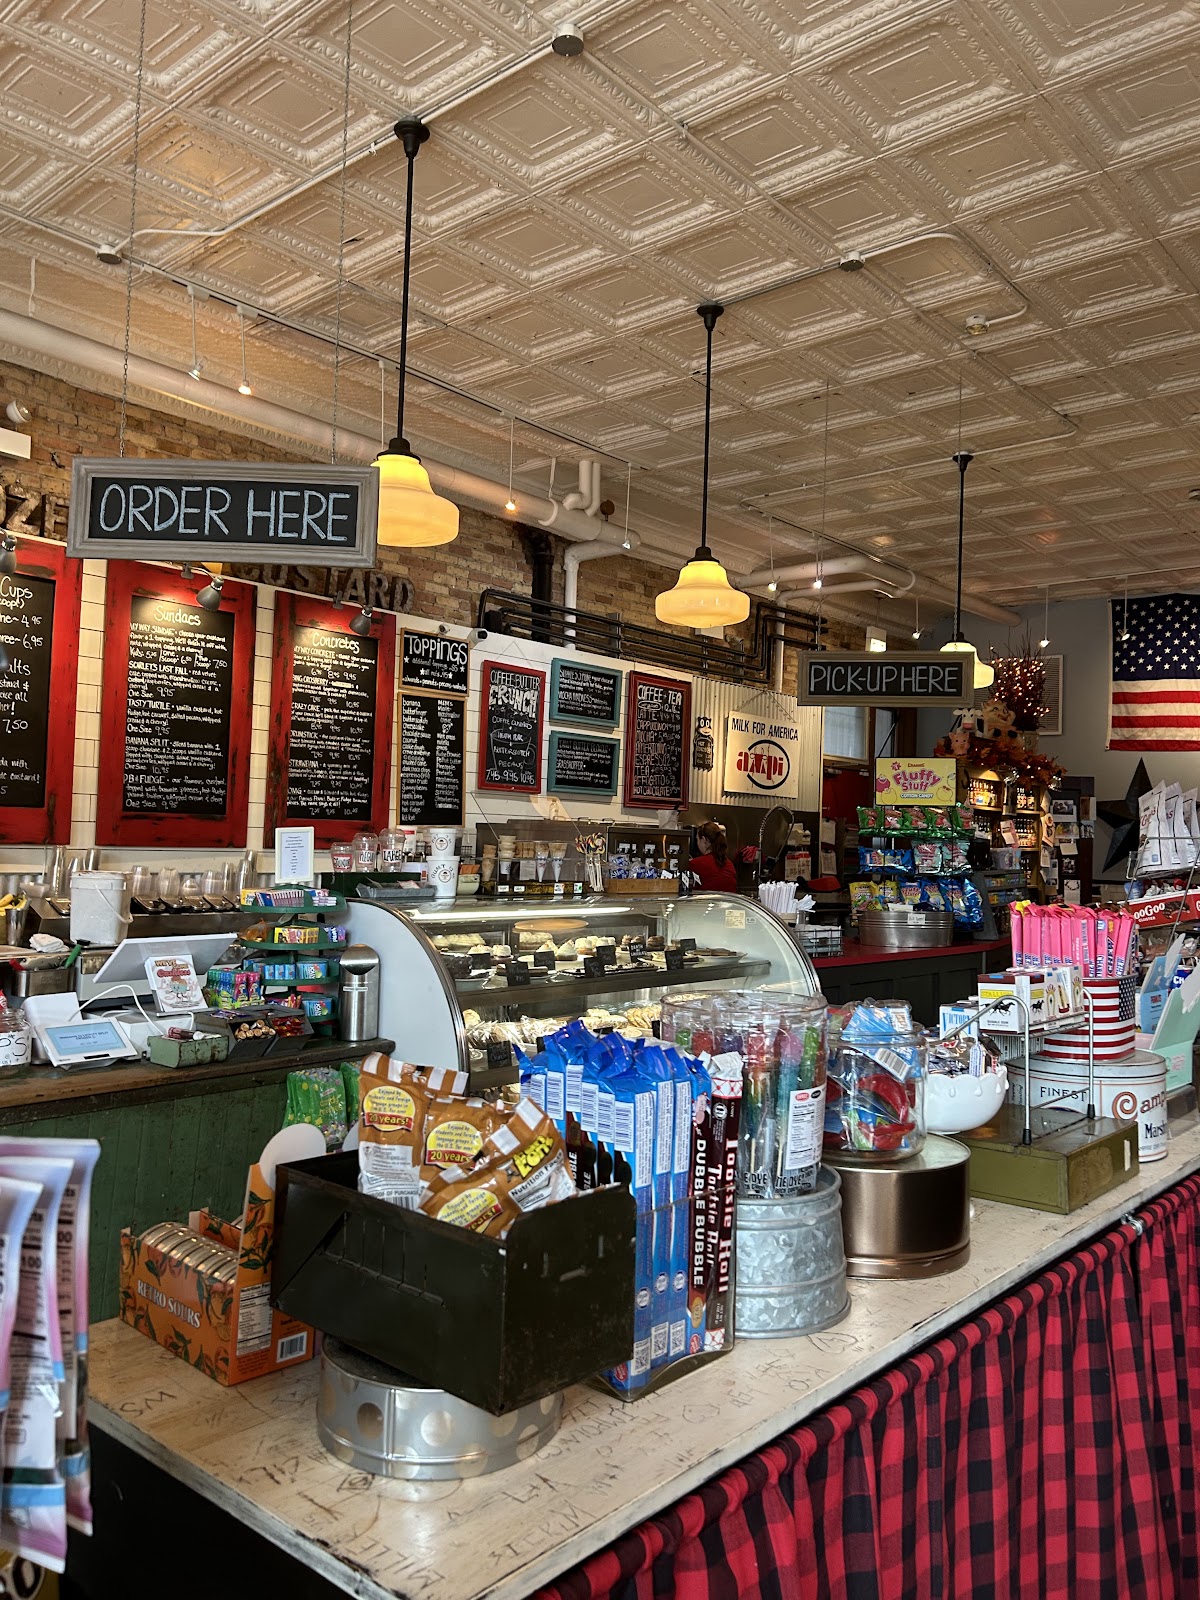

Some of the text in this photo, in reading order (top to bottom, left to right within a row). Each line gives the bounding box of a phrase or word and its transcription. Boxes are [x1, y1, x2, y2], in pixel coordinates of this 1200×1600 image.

[100, 483, 350, 542] ORDER HERE
[0, 576, 33, 603] Cups
[154, 605, 201, 626] Sundaes
[22, 634, 44, 650] 6.95
[313, 632, 360, 654] Concretes
[491, 670, 540, 691] COFFEE BUTTER
[810, 664, 959, 693] PICK-UP HERE
[157, 687, 175, 697] 9.95
[638, 685, 682, 705] COFFEE TEA
[127, 698, 146, 707] TASTY
[147, 700, 171, 711] TURTLE
[2, 718, 29, 733] 7.50
[731, 718, 798, 741] MILK FOR AMERICA
[140, 774, 165, 784] FUDGE
[635, 766, 649, 777] TEA
[893, 769, 941, 786] Fluffy
[901, 781, 931, 792] Stuff
[1134, 902, 1165, 920] ooGoo
[1040, 1086, 1087, 1102] FINEST
[380, 1115, 408, 1125] years!
[430, 1151, 471, 1163] 20 years
[511, 1170, 545, 1196] Nutrition
[694, 1139, 706, 1209] DUBBLE
[724, 1139, 739, 1228] Tootsie
[752, 1173, 767, 1184] DYE
[470, 1207, 496, 1230] ears!
[693, 1215, 706, 1287] BUBBLE
[137, 1279, 201, 1329] RETRO SOURS
